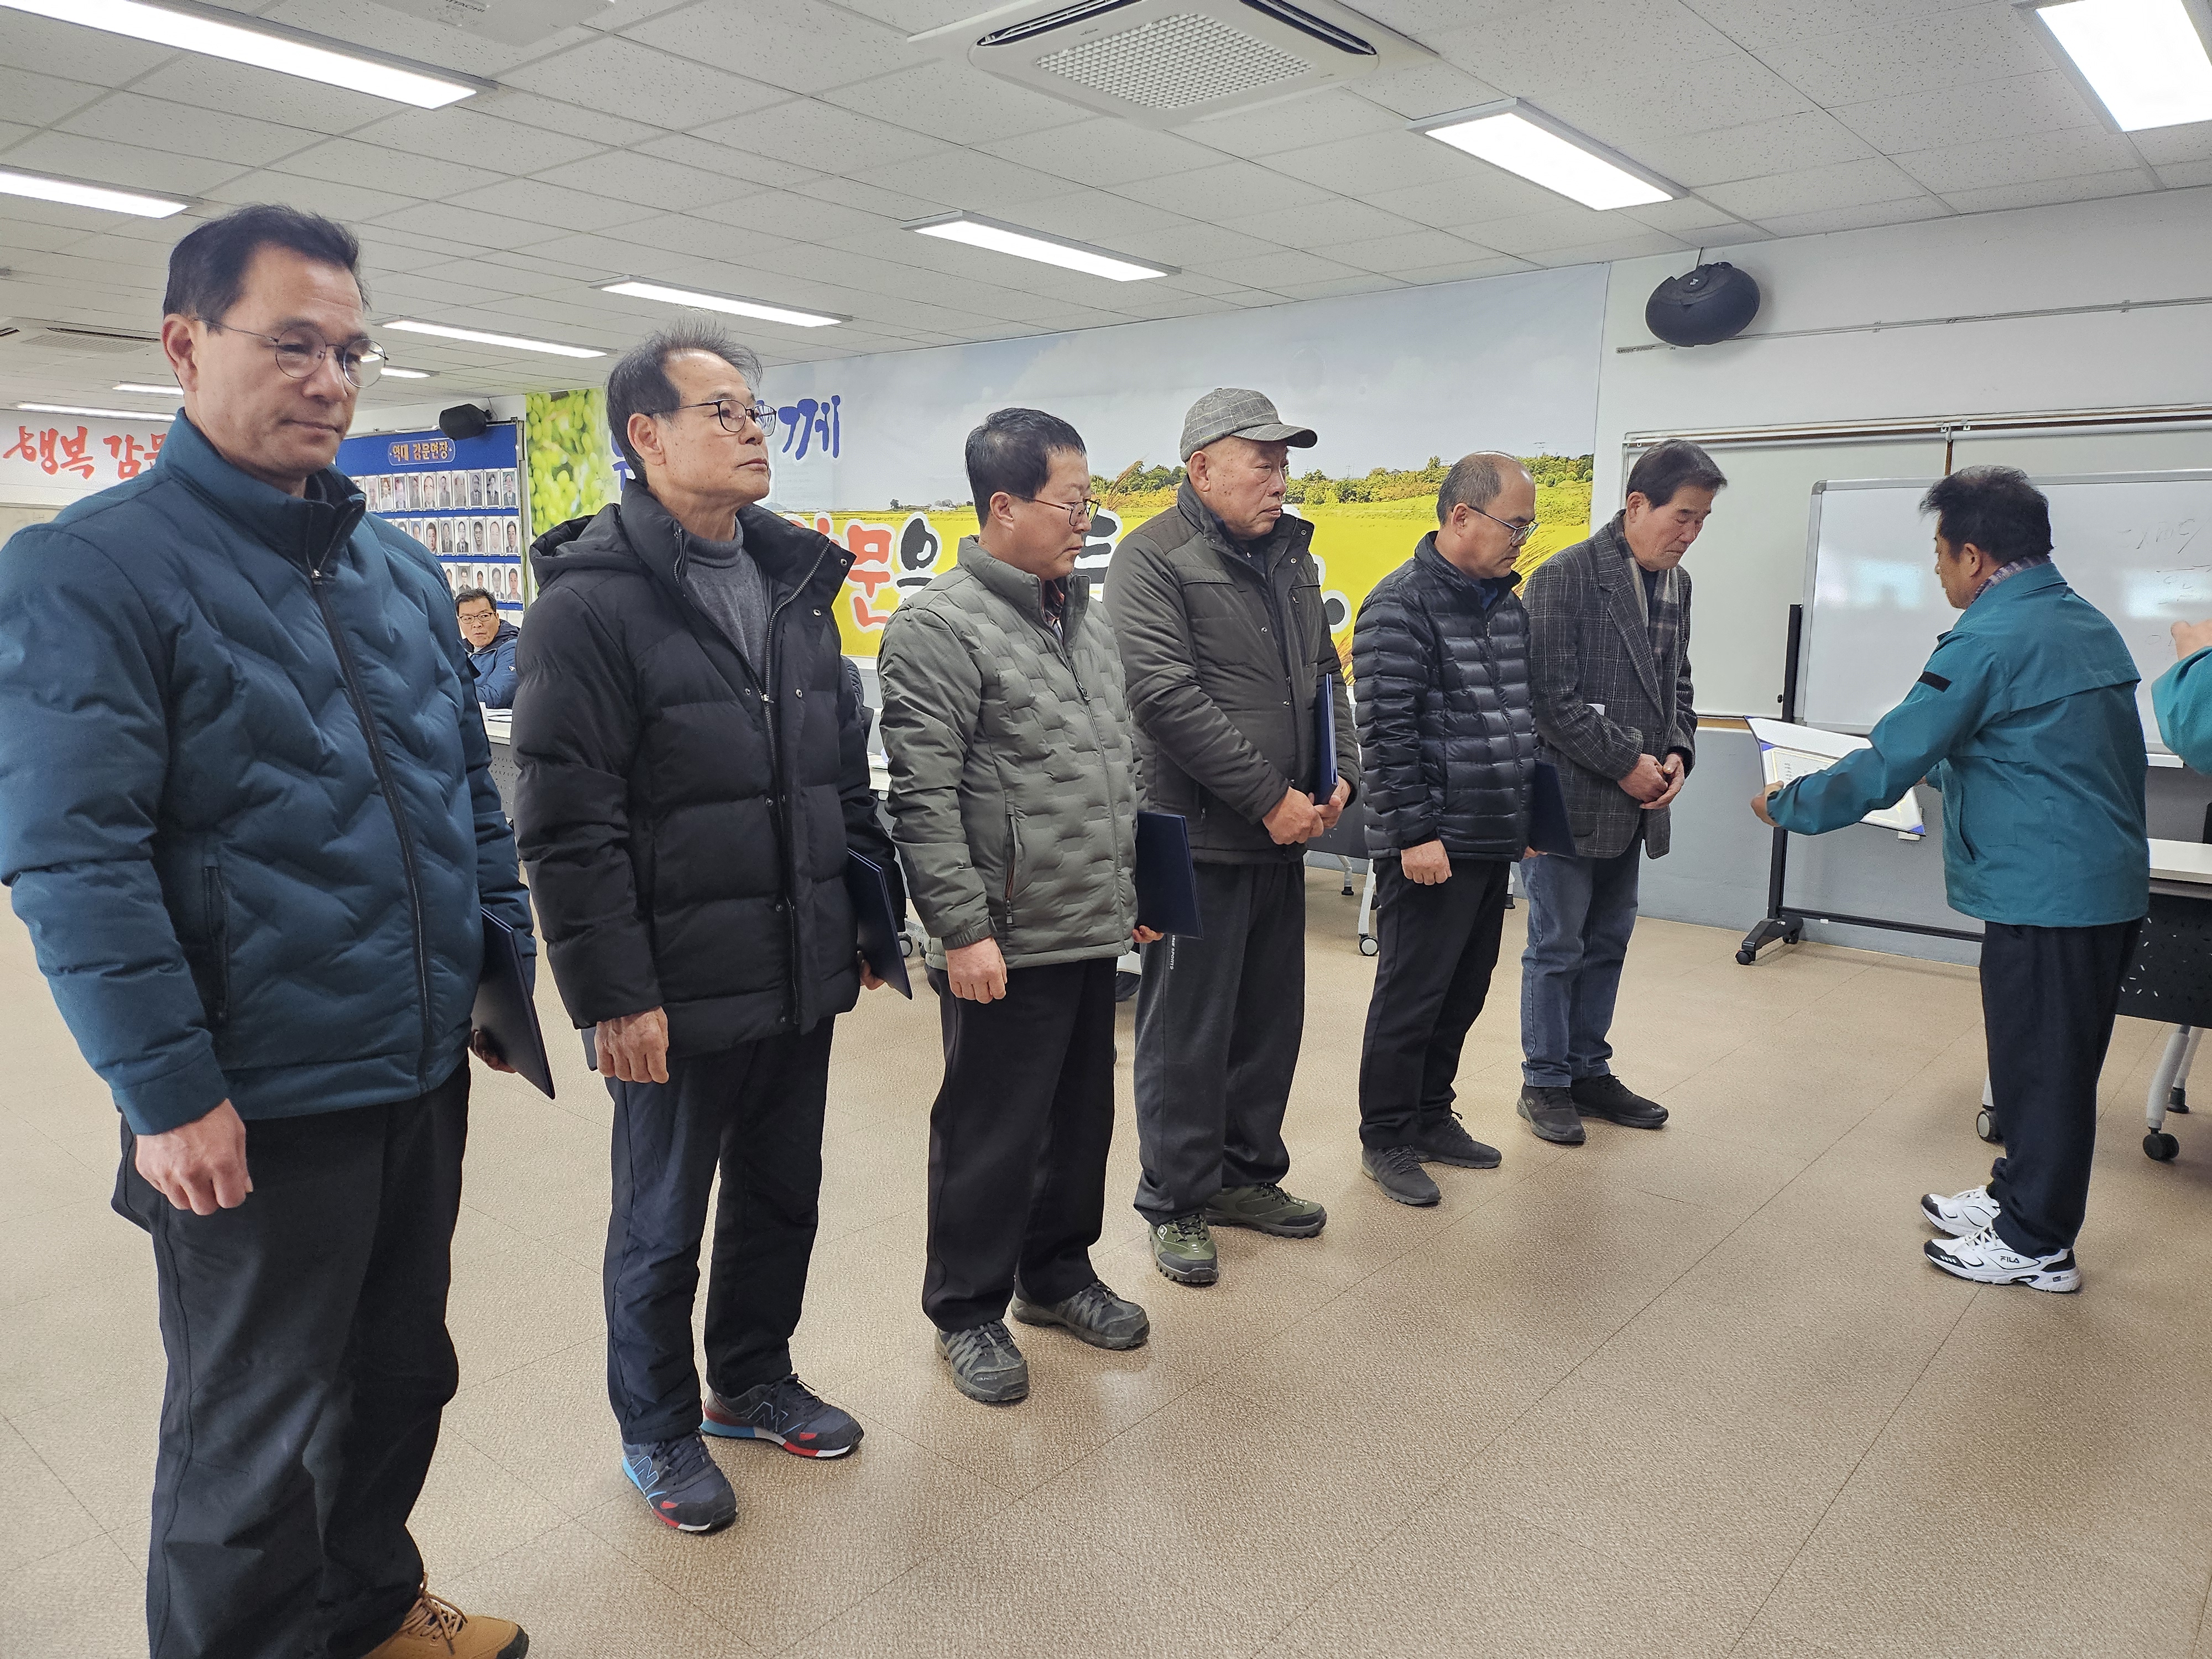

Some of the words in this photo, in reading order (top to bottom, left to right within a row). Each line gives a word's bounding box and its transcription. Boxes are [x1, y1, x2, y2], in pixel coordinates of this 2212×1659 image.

[755, 394, 841, 461] 께
[3, 426, 95, 480] 행복
[392, 444, 409, 462] 역대
[413, 440, 448, 460] 감문면장
[2000, 1255, 2020, 1264] FILA
